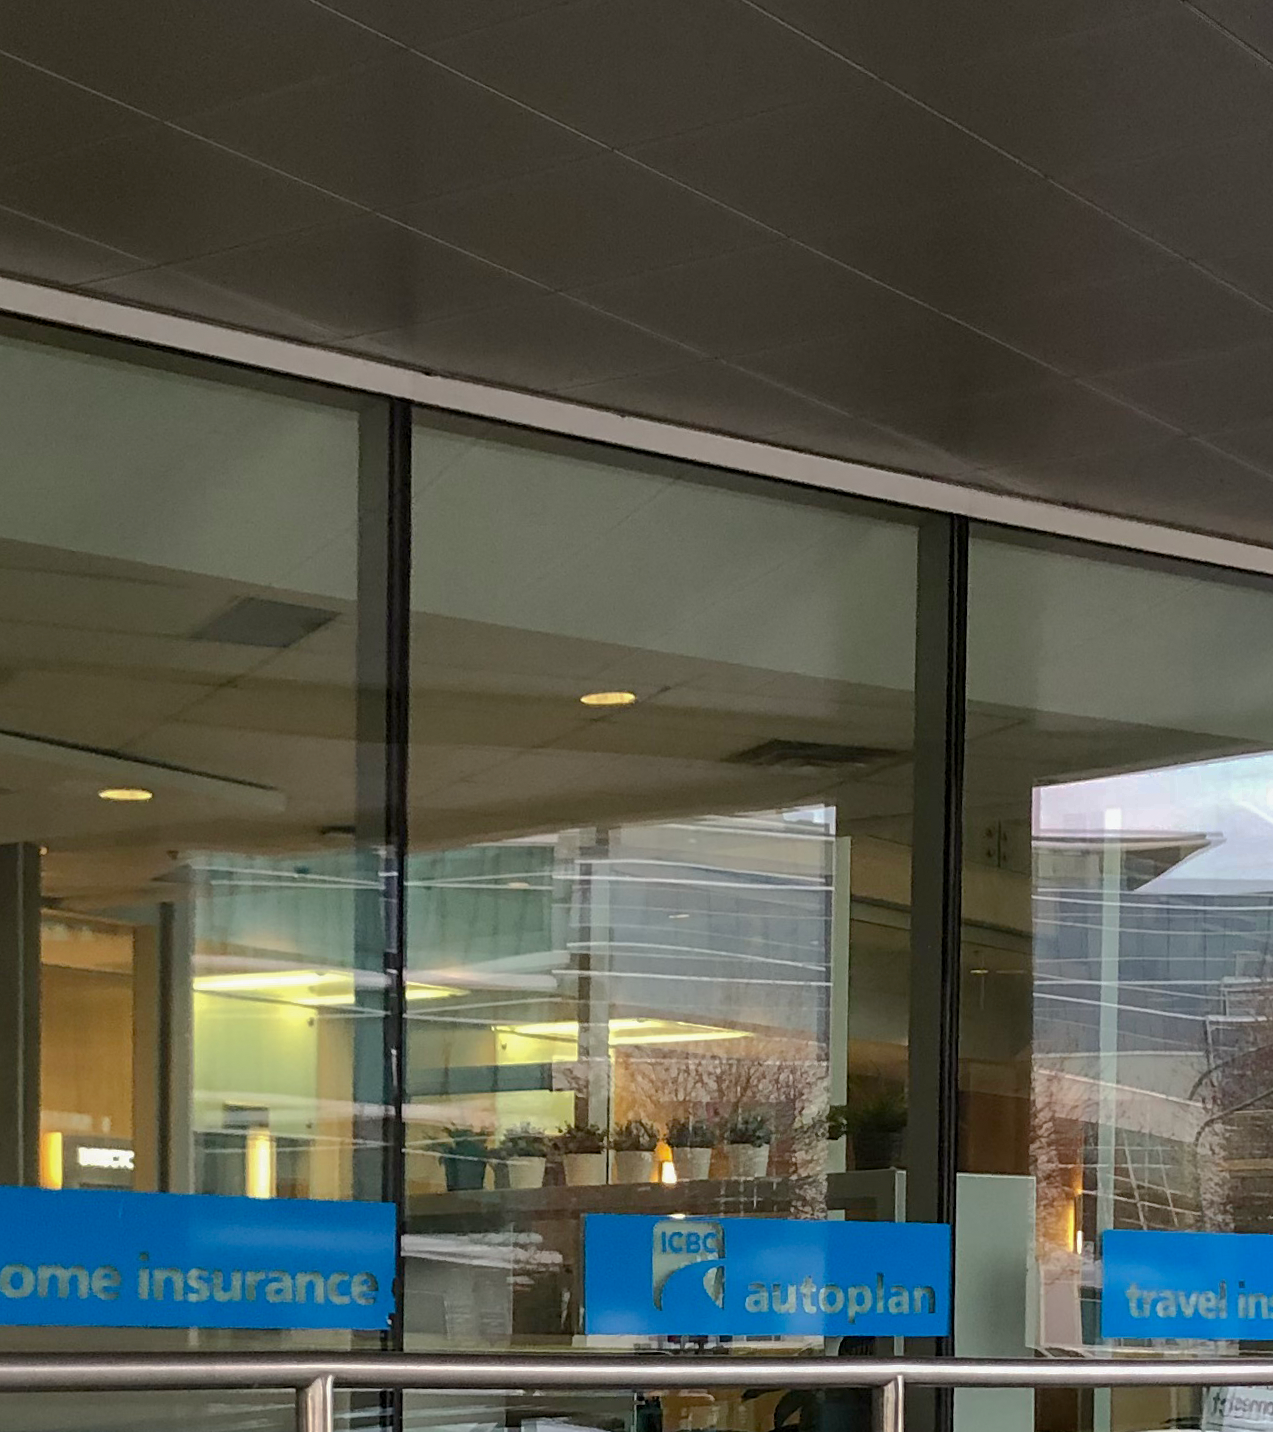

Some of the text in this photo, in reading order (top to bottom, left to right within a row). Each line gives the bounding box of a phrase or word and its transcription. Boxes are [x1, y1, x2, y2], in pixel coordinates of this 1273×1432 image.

[660, 1230, 717, 1254] ICBC
[137, 1253, 378, 1306] insurance
[745, 1273, 936, 1324] autoplan
[1126, 1280, 1227, 1320] travel
